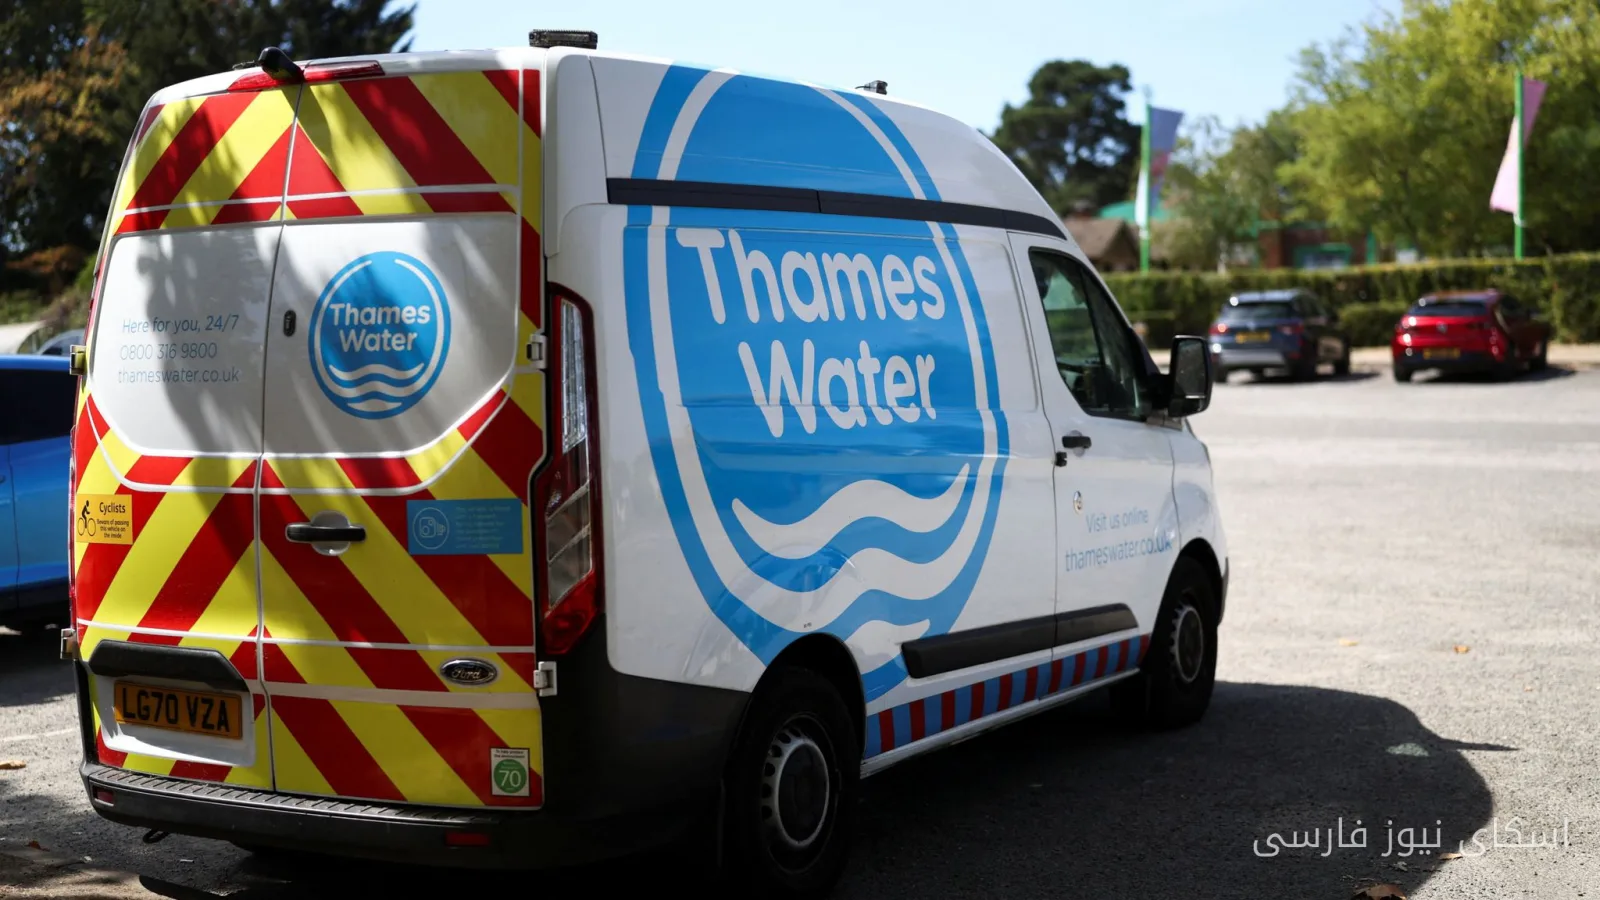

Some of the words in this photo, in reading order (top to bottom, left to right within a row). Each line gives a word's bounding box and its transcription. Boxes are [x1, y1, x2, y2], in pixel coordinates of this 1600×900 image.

[675, 228, 945, 325] Thames
[122, 318, 149, 333] Here
[152, 317, 169, 333] for
[172, 319, 201, 335] you,
[205, 314, 239, 332] 24/7
[329, 303, 431, 326] Thames
[120, 344, 152, 360] 0800
[156, 343, 177, 359] 316
[180, 342, 218, 359] 9800
[339, 329, 418, 352] Water
[118, 366, 240, 384] thameswater.co.uk
[738, 339, 937, 438] Water
[99, 501, 126, 515] Cyclists
[1086, 512, 1107, 533] Visit
[1109, 514, 1120, 529] us
[1122, 507, 1148, 528] online
[1065, 530, 1173, 572] thameswater.co.uk
[451, 666, 483, 680] Ford
[122, 687, 179, 725] LG70
[186, 696, 230, 732] VZA
[498, 770, 521, 788] 70
